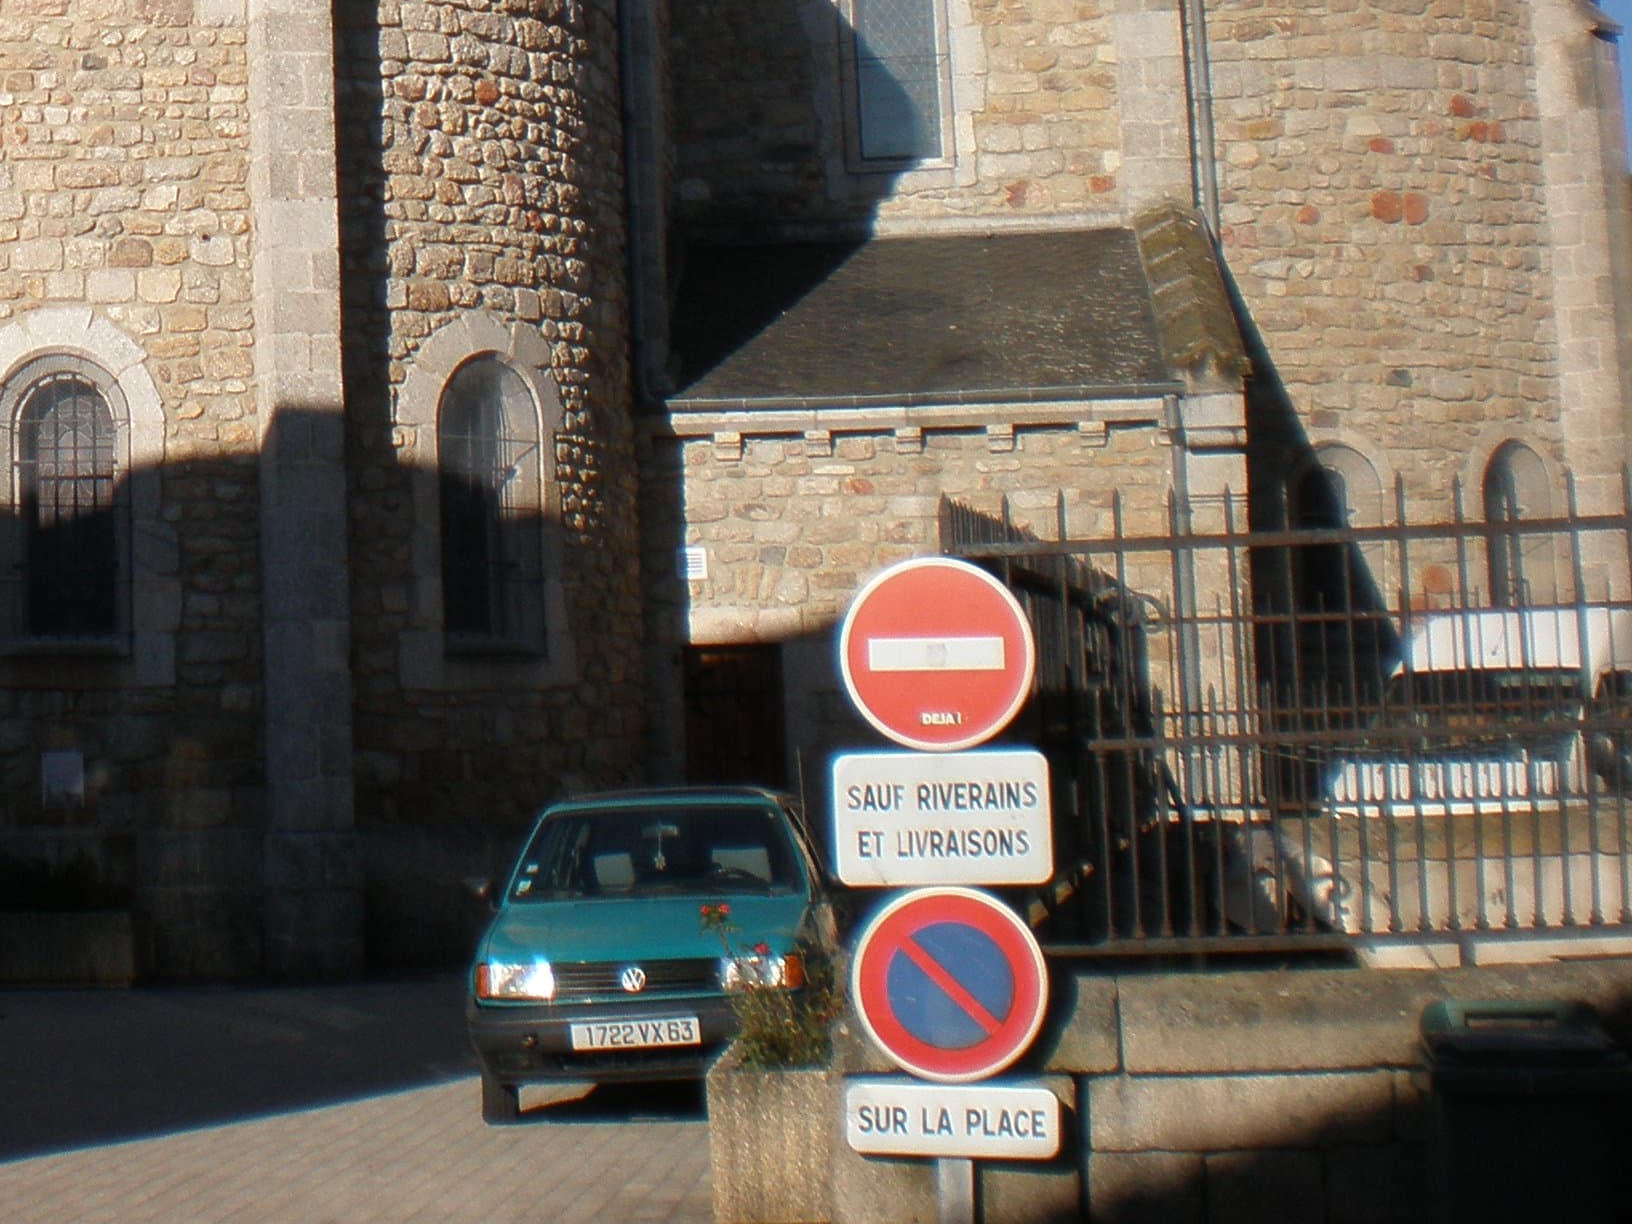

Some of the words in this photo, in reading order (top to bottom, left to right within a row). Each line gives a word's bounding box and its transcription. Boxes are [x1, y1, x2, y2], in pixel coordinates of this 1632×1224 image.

[847, 784, 905, 811] SAUF
[917, 781, 1038, 810] RIVERAINS
[858, 830, 884, 857] ET
[897, 829, 1030, 857] LIVRAISONS
[858, 1106, 908, 1134] SUR
[922, 1107, 953, 1136] LA
[965, 1108, 1046, 1138] PLACE
